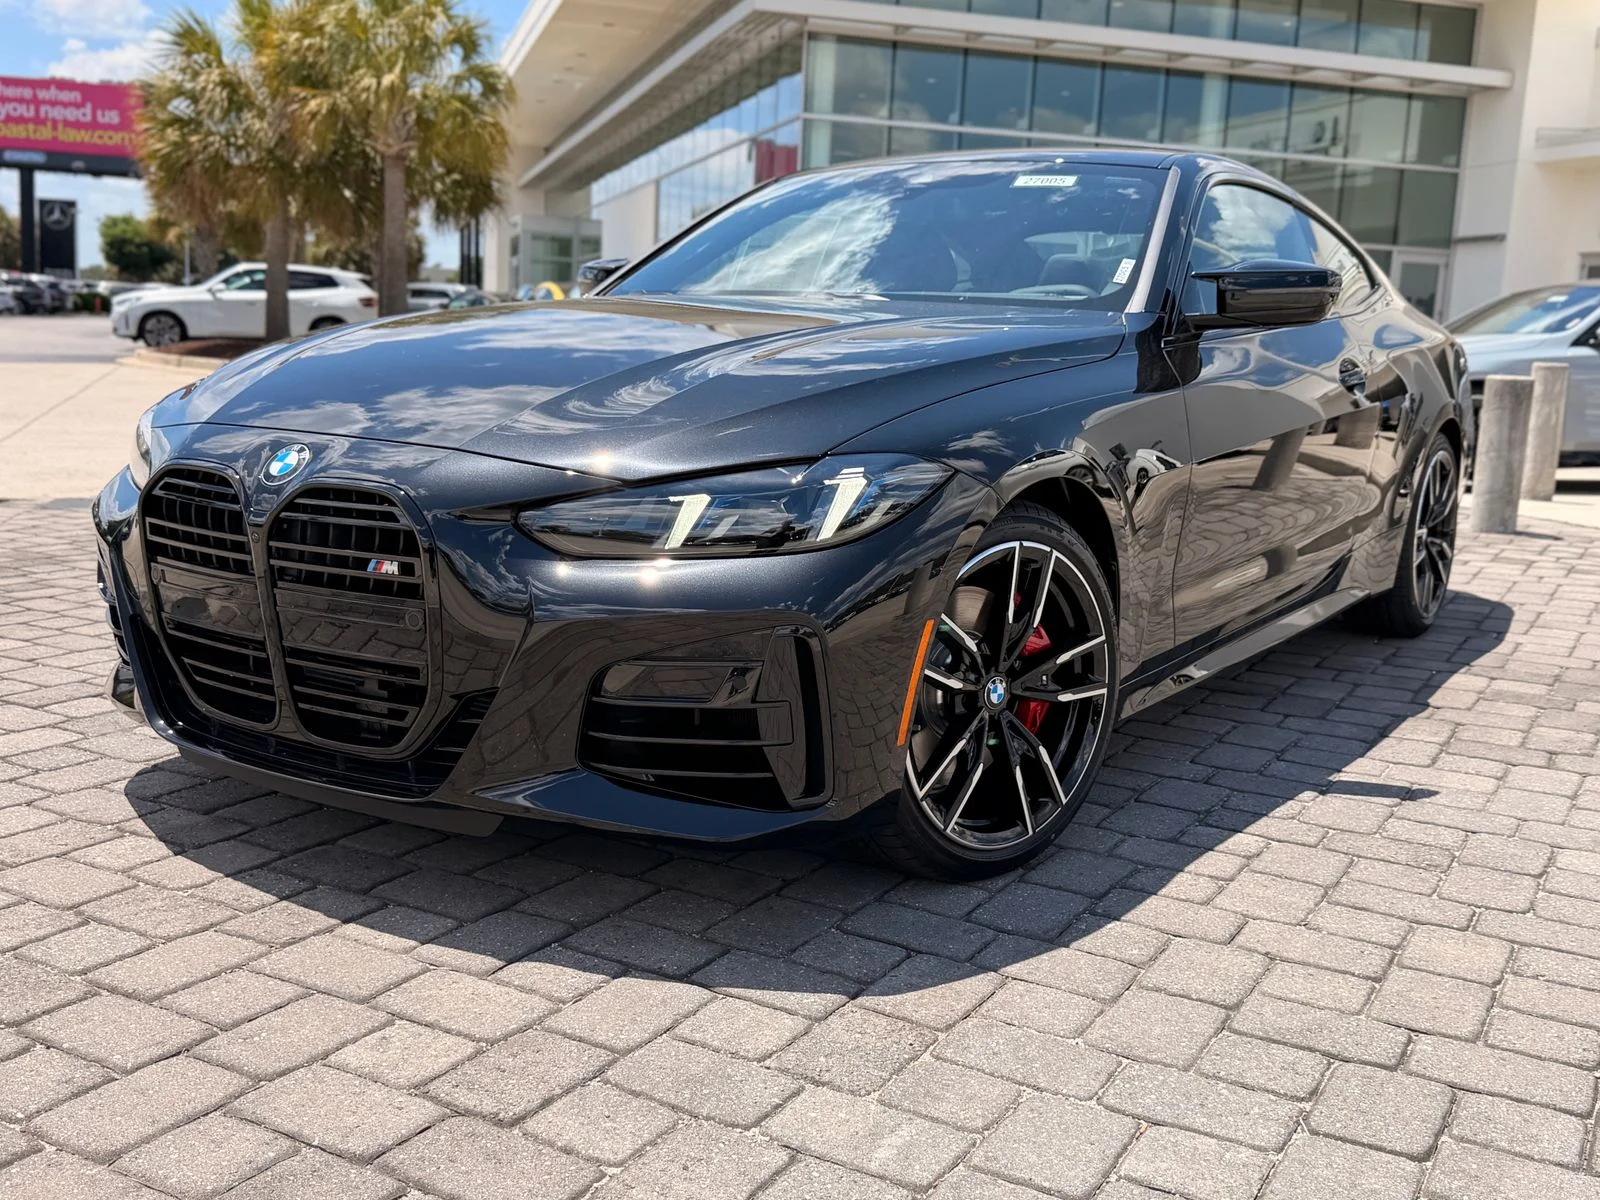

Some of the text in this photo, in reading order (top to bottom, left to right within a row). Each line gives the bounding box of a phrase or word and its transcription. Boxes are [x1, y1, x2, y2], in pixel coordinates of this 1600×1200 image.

[35, 85, 82, 102] when
[0, 101, 121, 125] you need us
[1023, 177, 1067, 185] 27005
